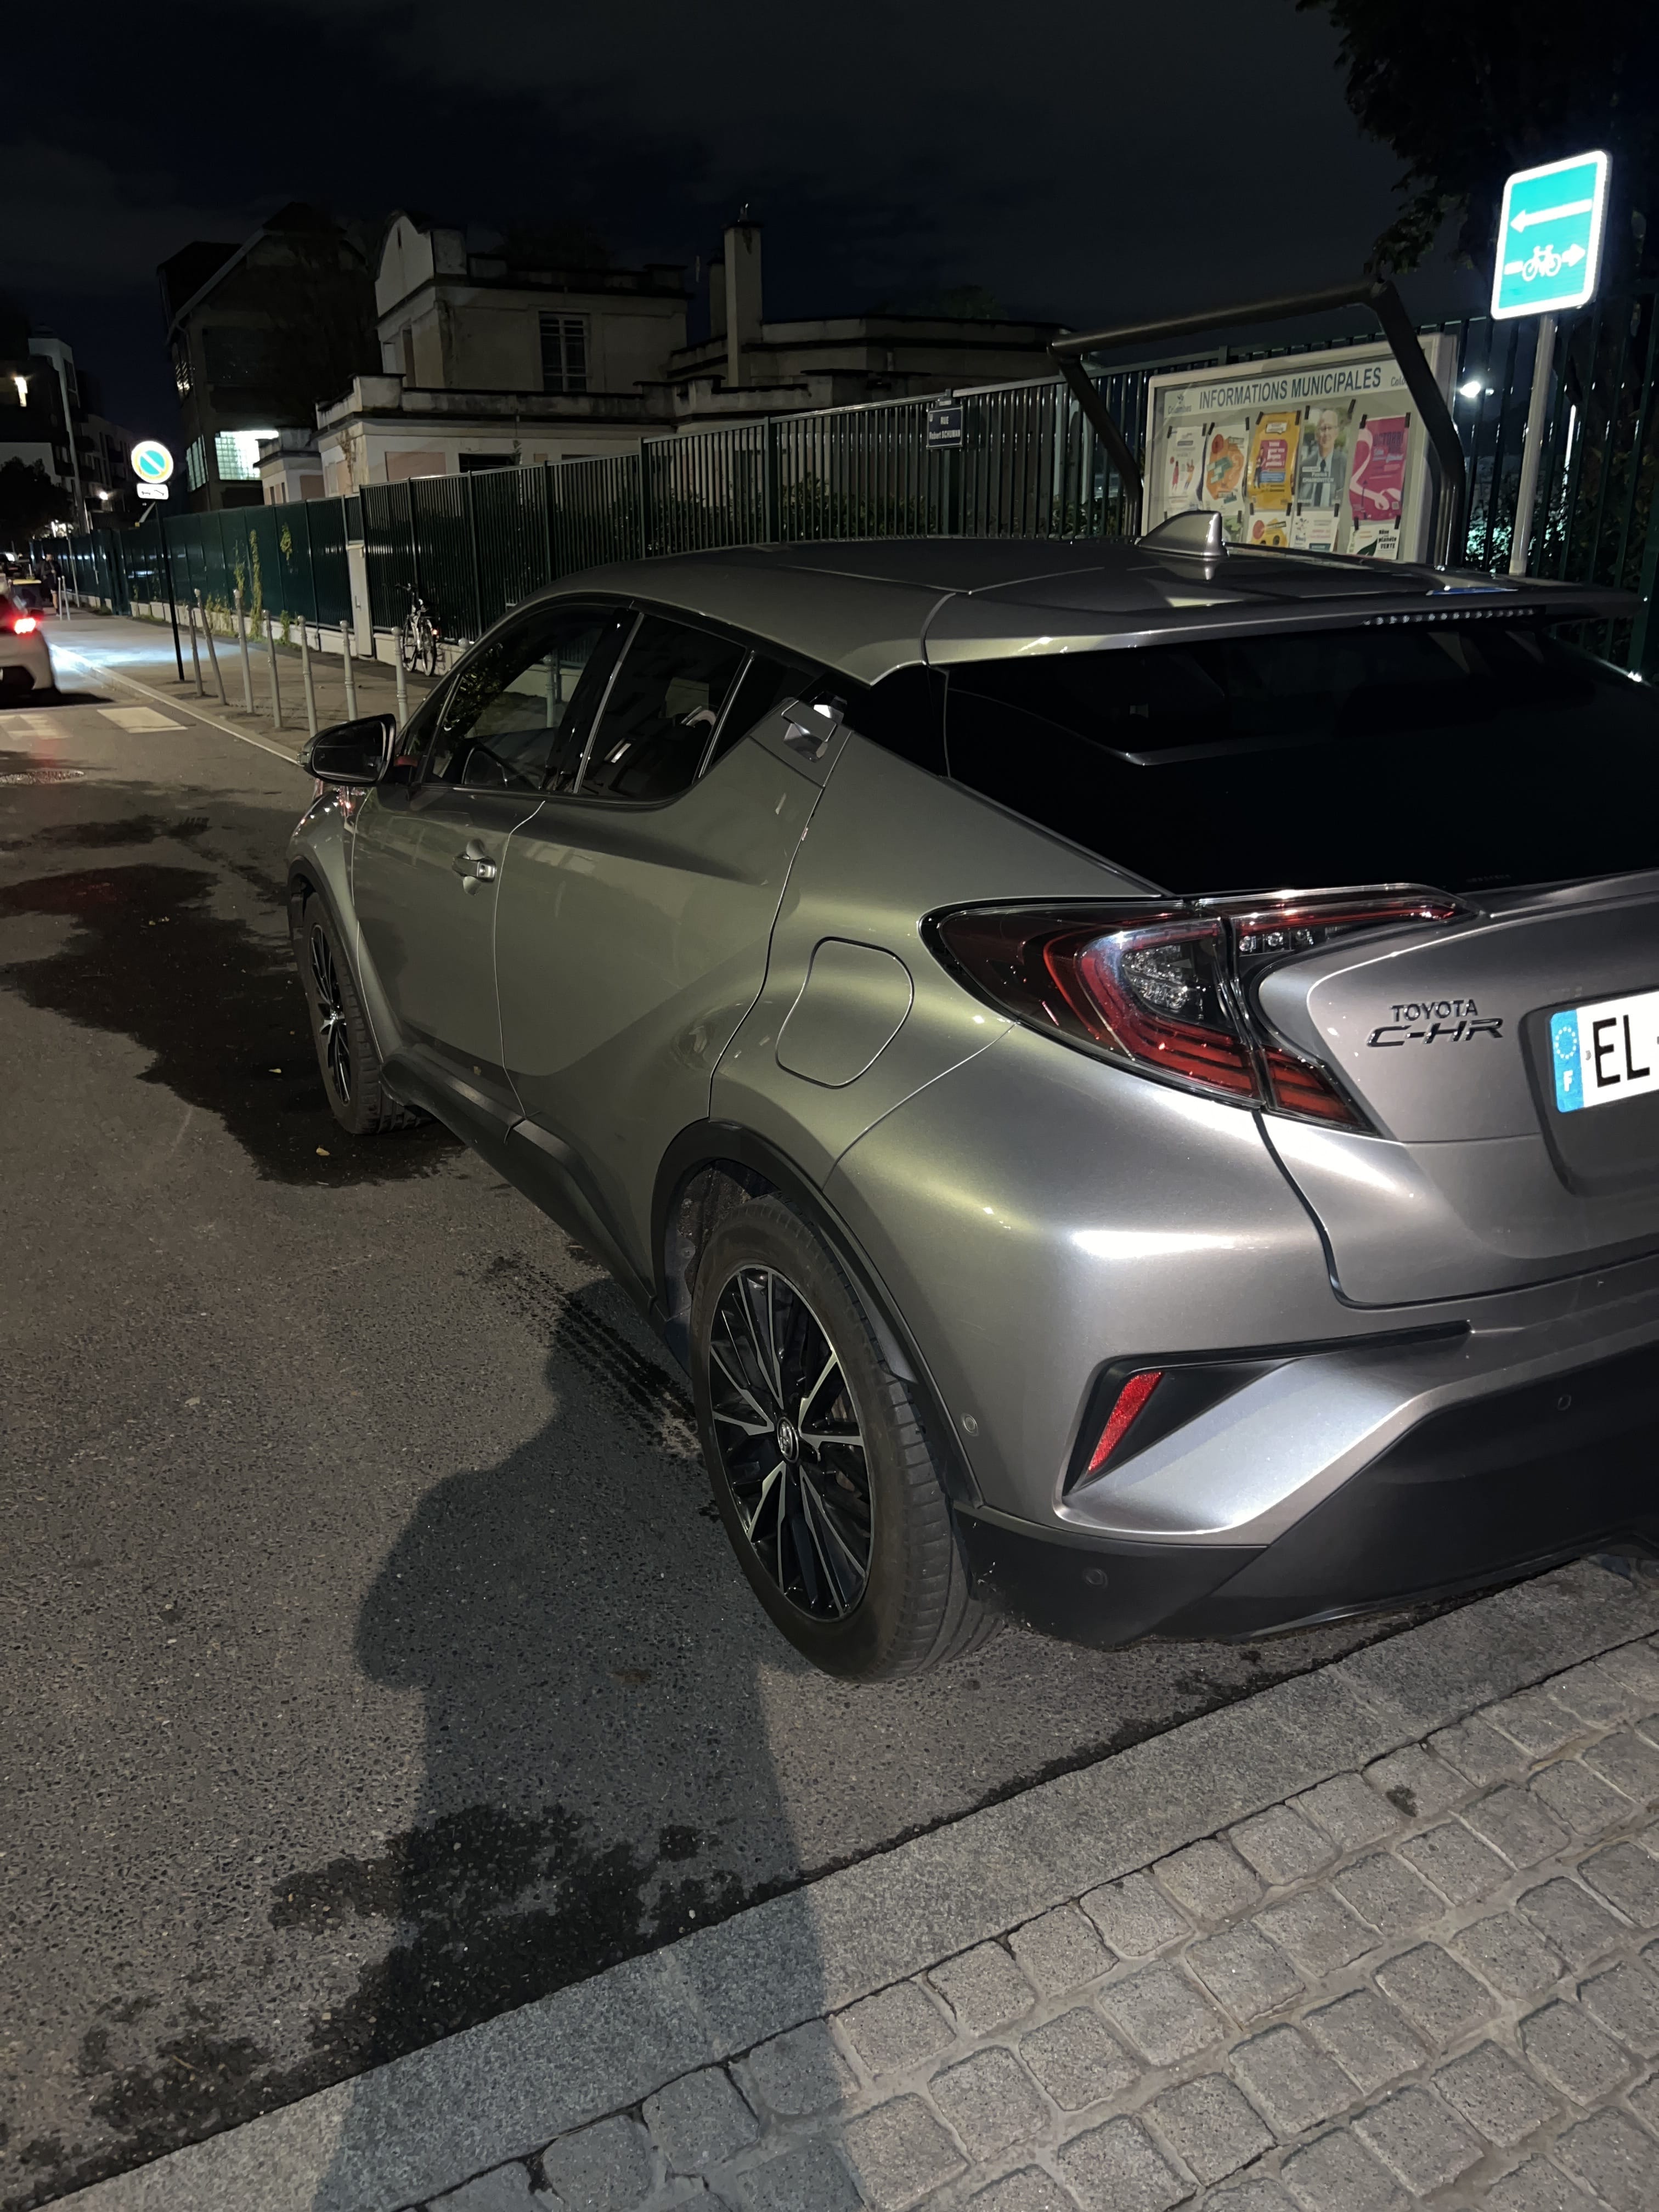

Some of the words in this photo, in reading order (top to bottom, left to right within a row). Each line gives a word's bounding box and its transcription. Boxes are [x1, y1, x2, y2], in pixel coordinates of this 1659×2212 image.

[1199, 380, 1288, 409] INFORMATIONS
[1291, 367, 1381, 398] MUNICIPALES
[1391, 999, 1479, 1022] TOYOTA
[1366, 1018, 1504, 1048] C-HR
[1562, 1070, 1573, 1092] F
